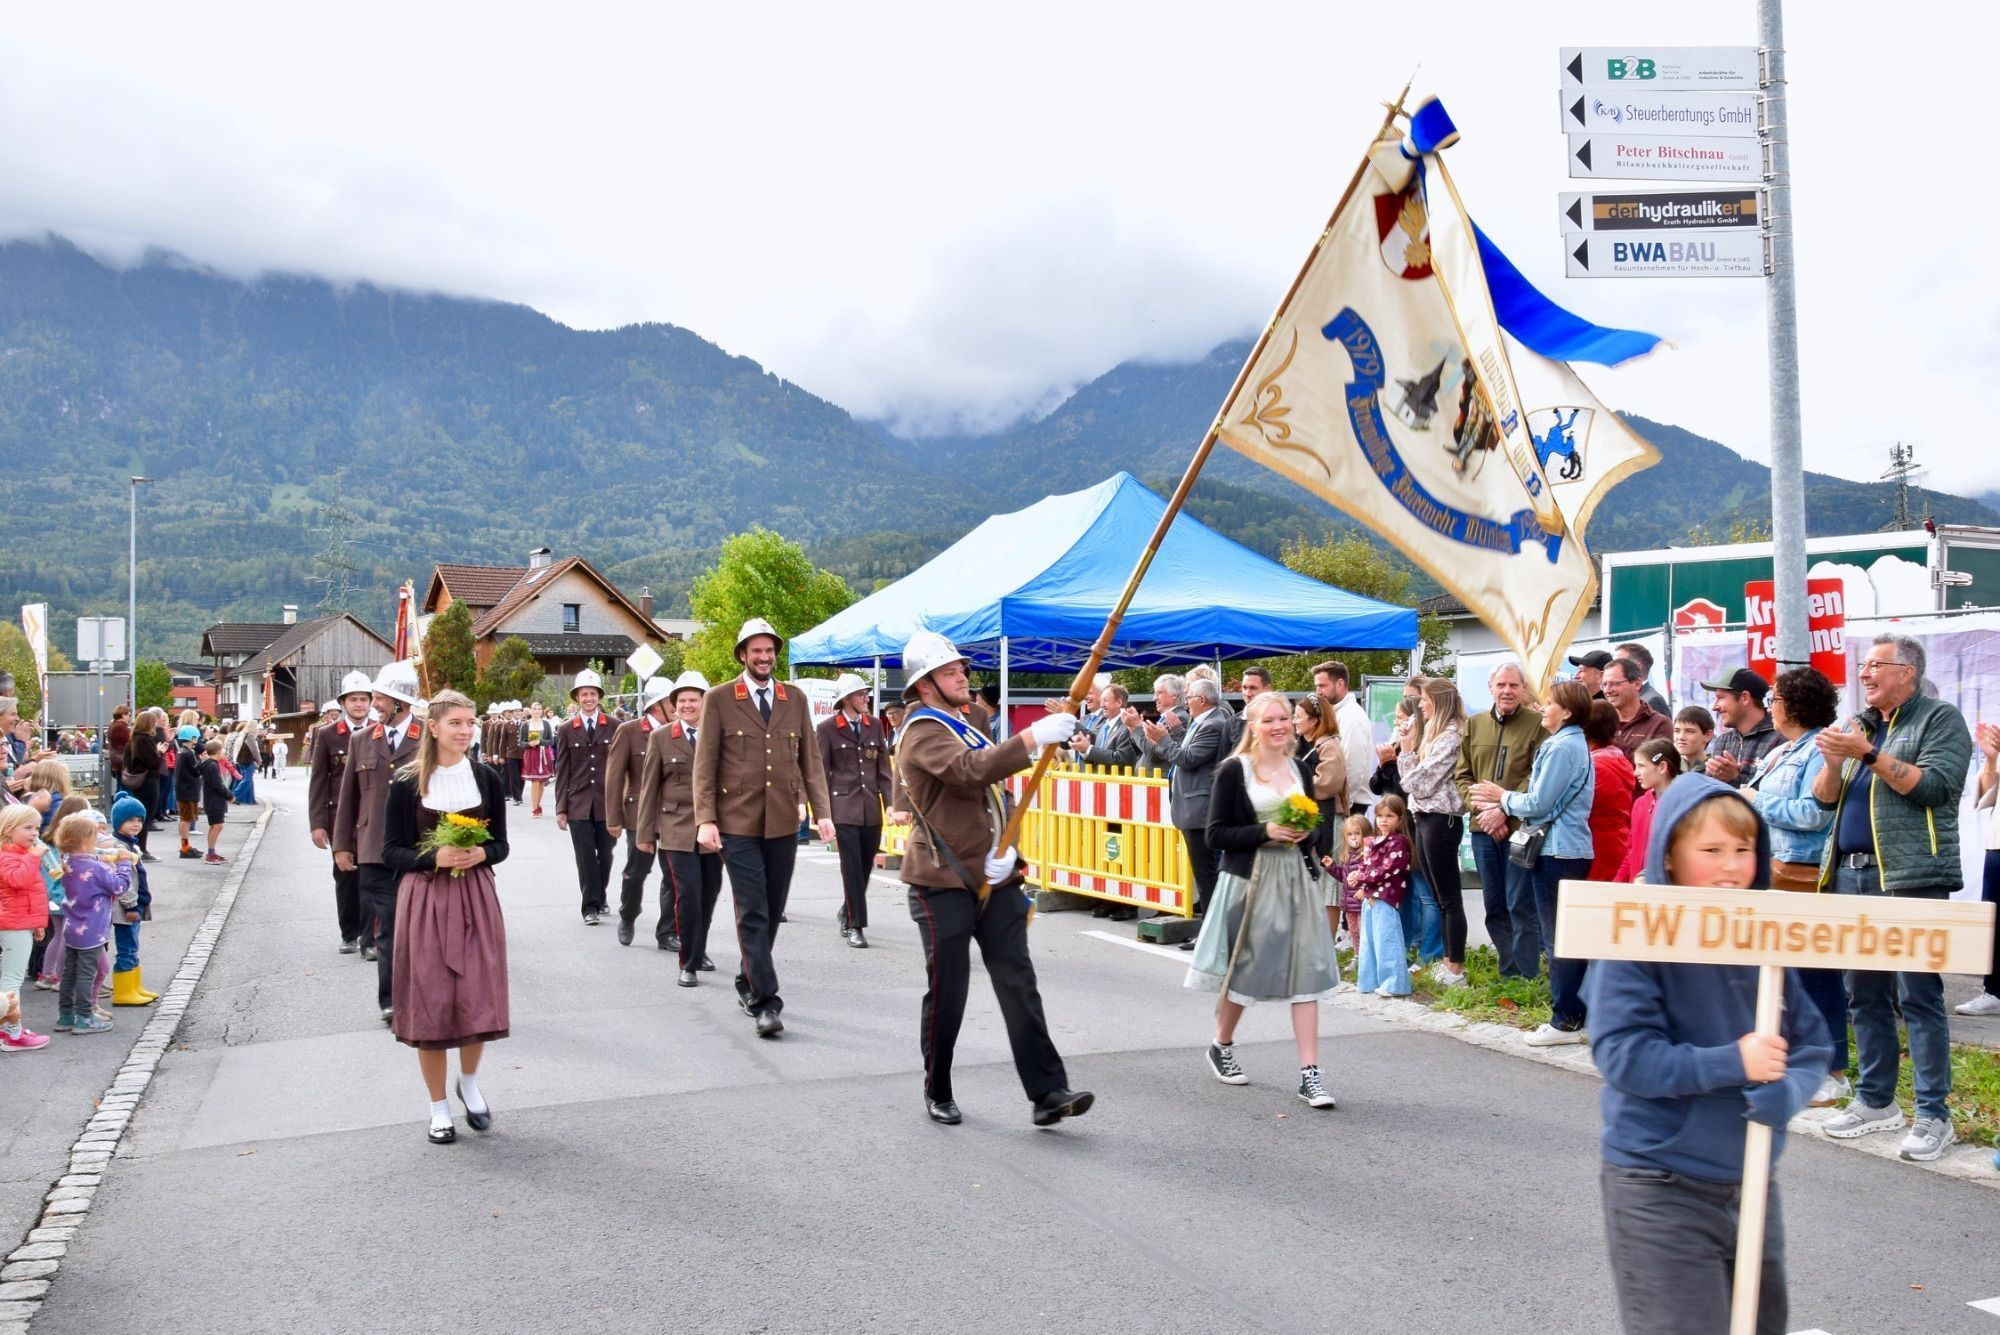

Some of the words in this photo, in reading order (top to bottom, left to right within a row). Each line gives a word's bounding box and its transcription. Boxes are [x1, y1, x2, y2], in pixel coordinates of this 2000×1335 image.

[1607, 56, 1657, 80] B2B
[1626, 104, 1715, 125] Steuerberatungs
[1719, 106, 1752, 124] GmbH
[1617, 144, 1652, 157] Peter
[1658, 146, 1724, 160] Bitschnau
[1608, 200, 1740, 223] derhydrauliker
[1345, 327, 1380, 376] 1979
[1745, 591, 1843, 627] Kren
[1748, 627, 1845, 661] Zeng
[1612, 901, 1686, 946] FW
[1699, 906, 1951, 971] Dünserberg
